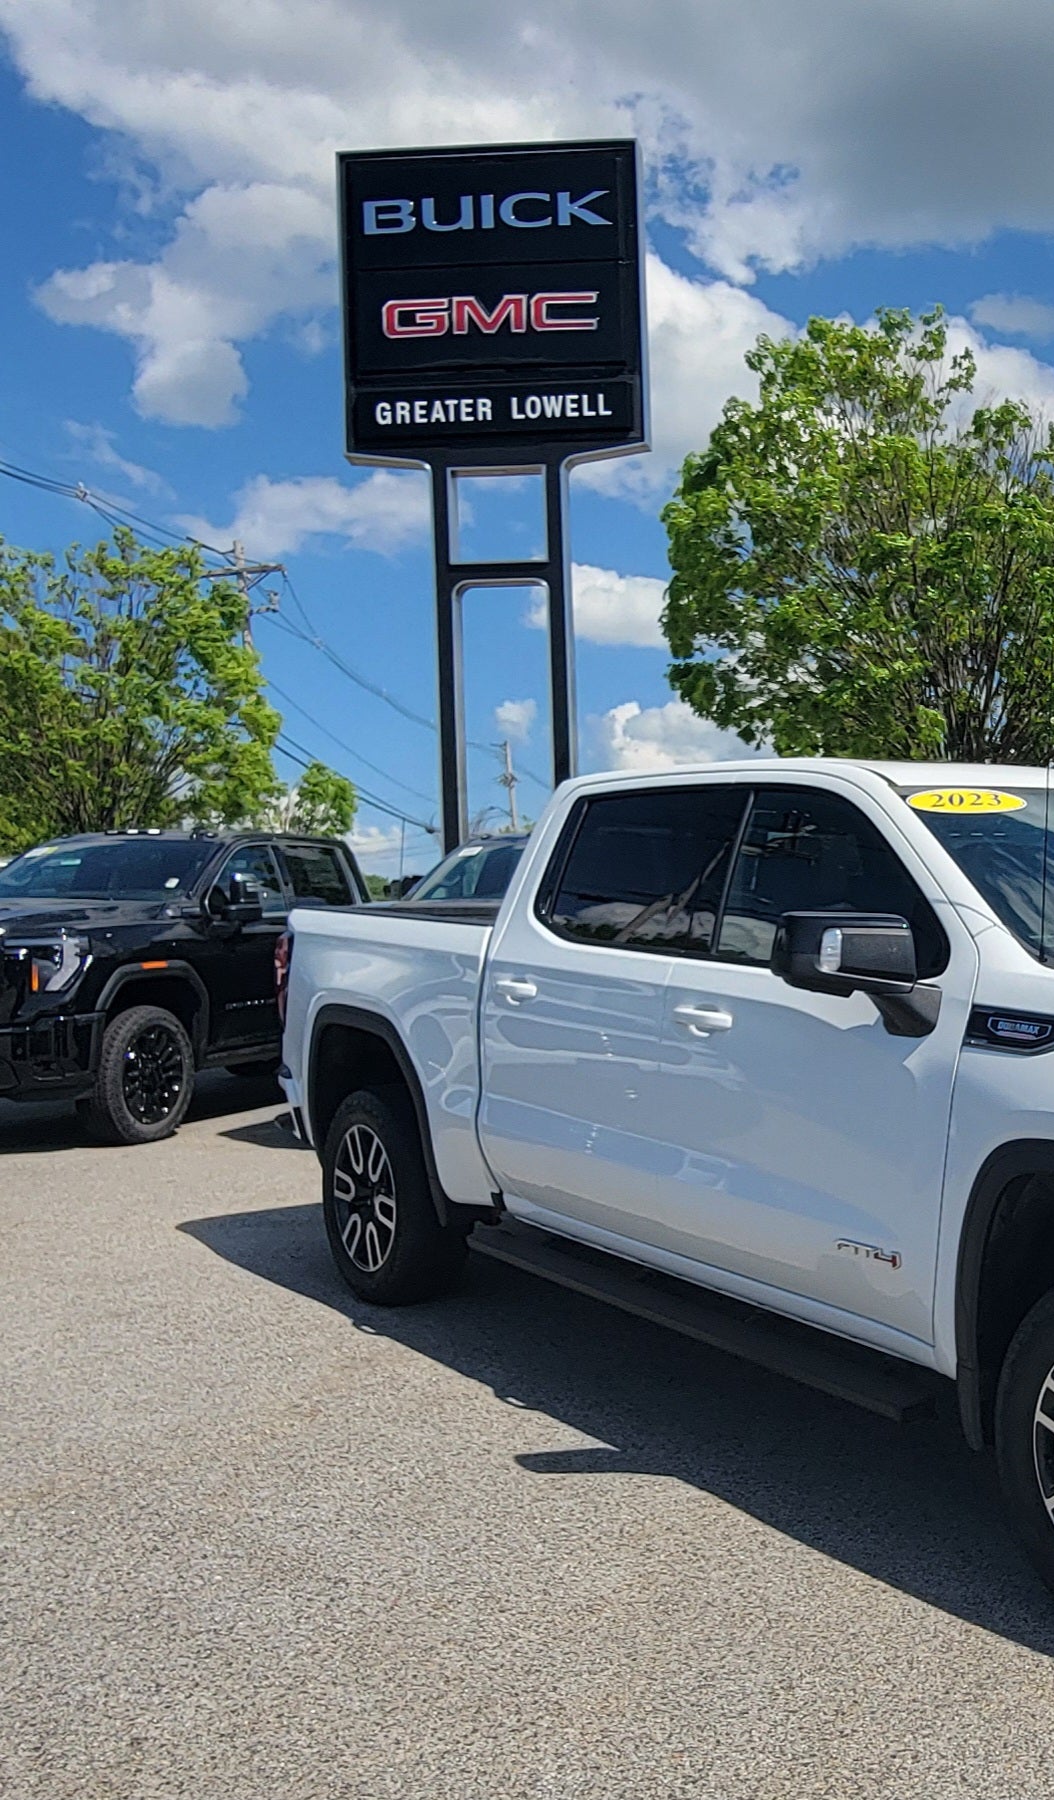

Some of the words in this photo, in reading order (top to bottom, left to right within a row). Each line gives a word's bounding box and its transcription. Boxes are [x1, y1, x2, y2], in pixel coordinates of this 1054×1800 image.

[362, 190, 613, 235] BUICK
[382, 291, 600, 339] GMC
[375, 398, 493, 425] GREATER
[511, 394, 612, 420] LOWELL
[930, 792, 1002, 808] 2023
